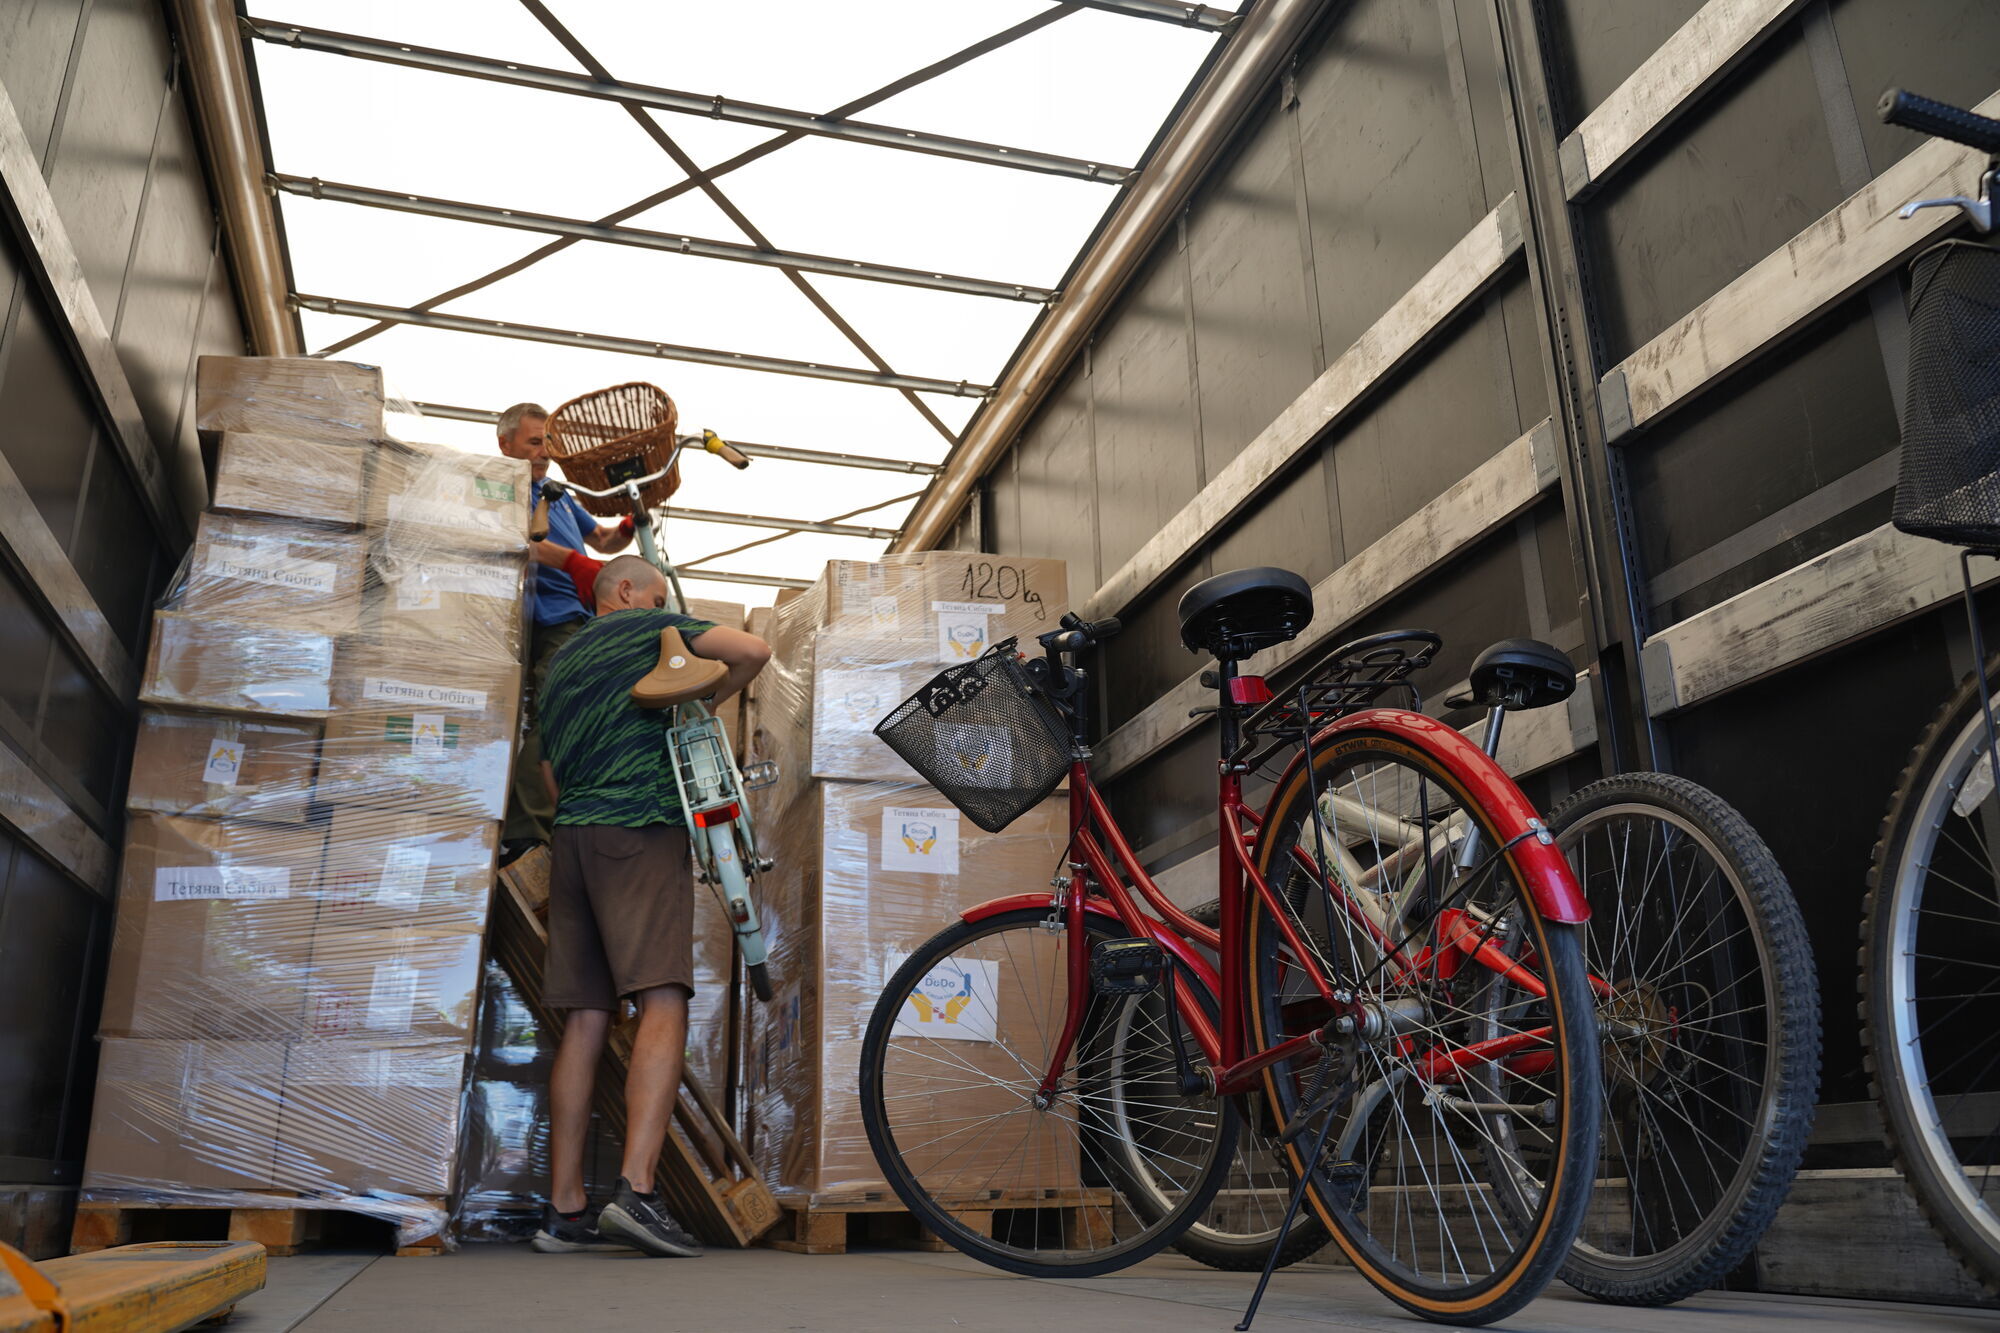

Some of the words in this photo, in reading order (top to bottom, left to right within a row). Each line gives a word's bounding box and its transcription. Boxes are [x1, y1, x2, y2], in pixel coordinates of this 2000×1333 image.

[221, 560, 269, 580] Тетяна
[377, 680, 425, 698] Тетяна
[428, 687, 476, 705] Сибіга
[168, 881, 220, 896] Тетяна
[224, 880, 277, 895] Сибіга
[924, 977, 956, 989] DoDo
